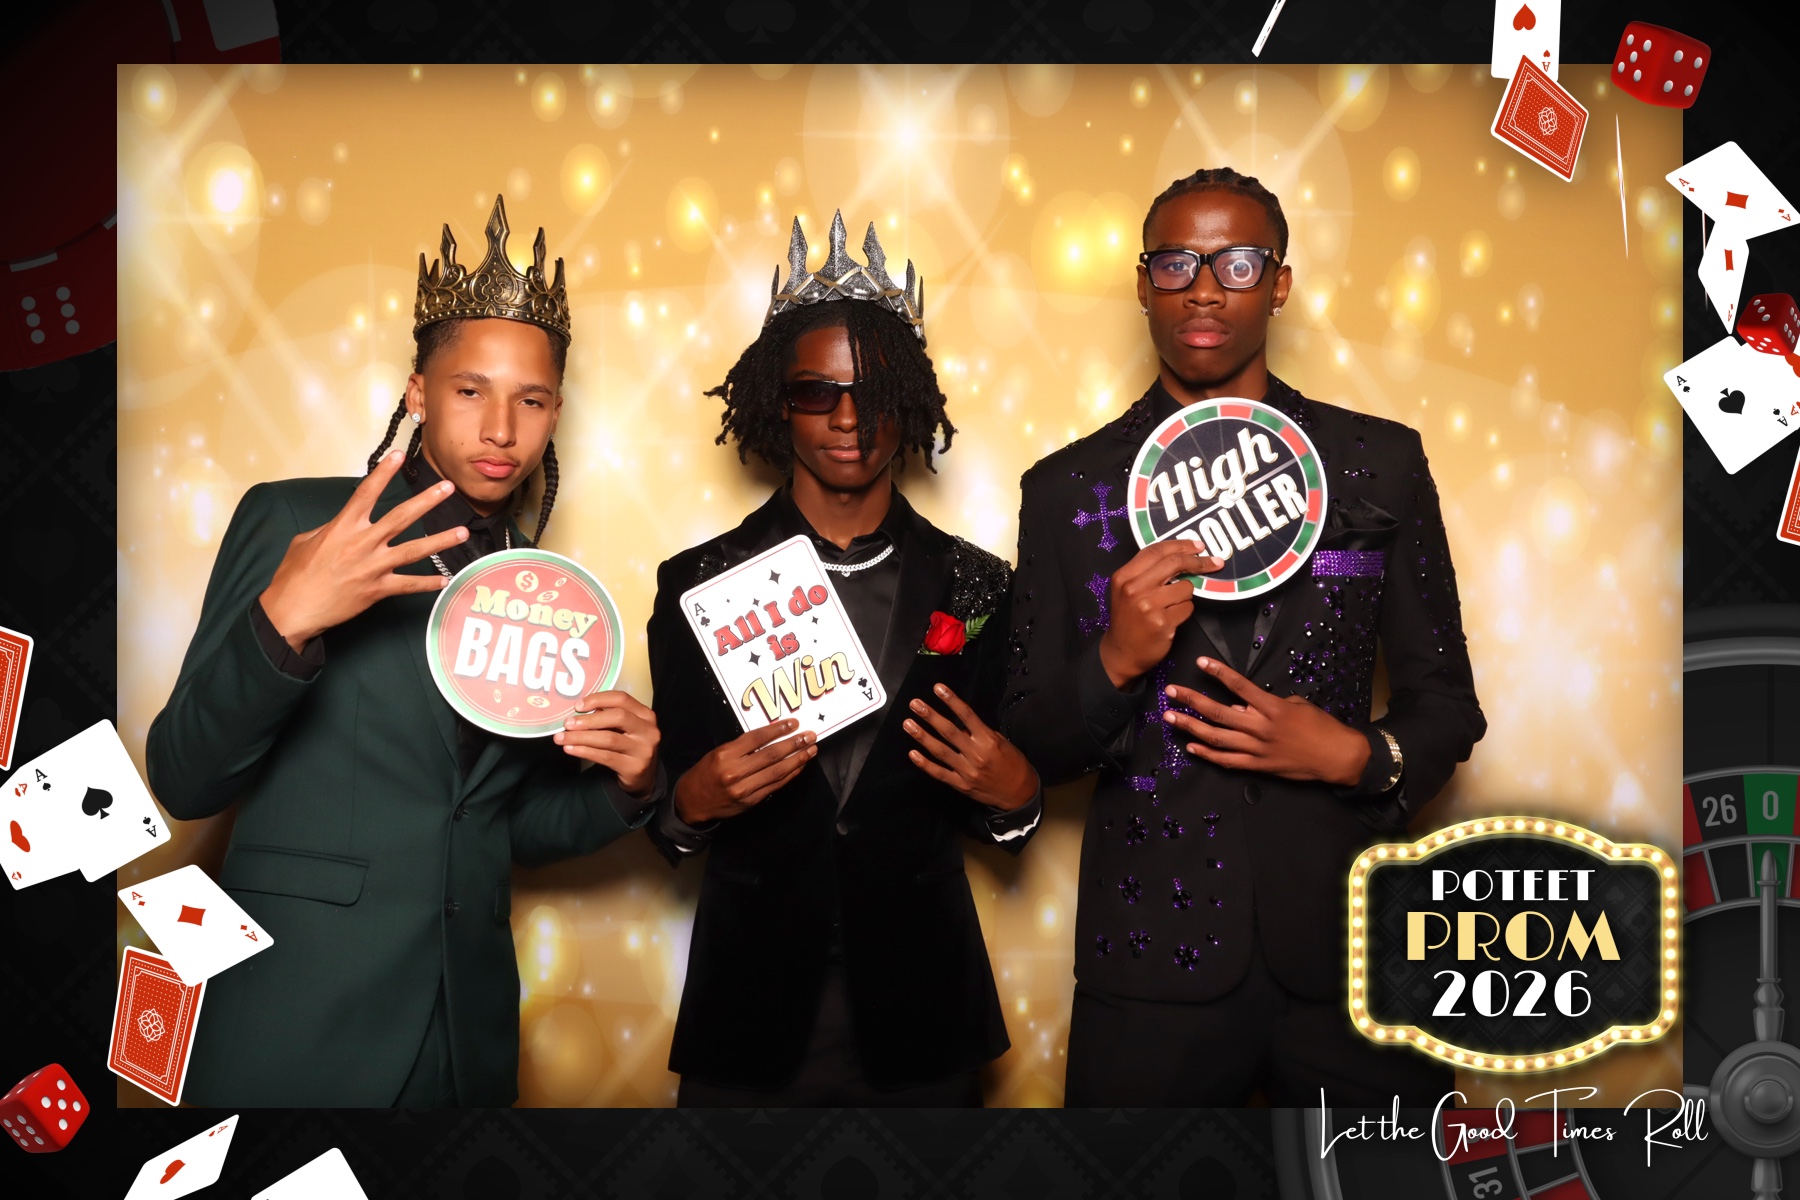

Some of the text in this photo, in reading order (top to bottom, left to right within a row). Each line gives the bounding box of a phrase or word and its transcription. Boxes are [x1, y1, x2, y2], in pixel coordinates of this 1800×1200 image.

[1148, 427, 1279, 523] High
[470, 585, 598, 639] Money
[693, 602, 707, 617] A
[713, 584, 829, 657] All I do
[453, 616, 591, 698] BAGS
[766, 632, 800, 661] is
[741, 651, 856, 724] Win
[861, 687, 875, 702] A
